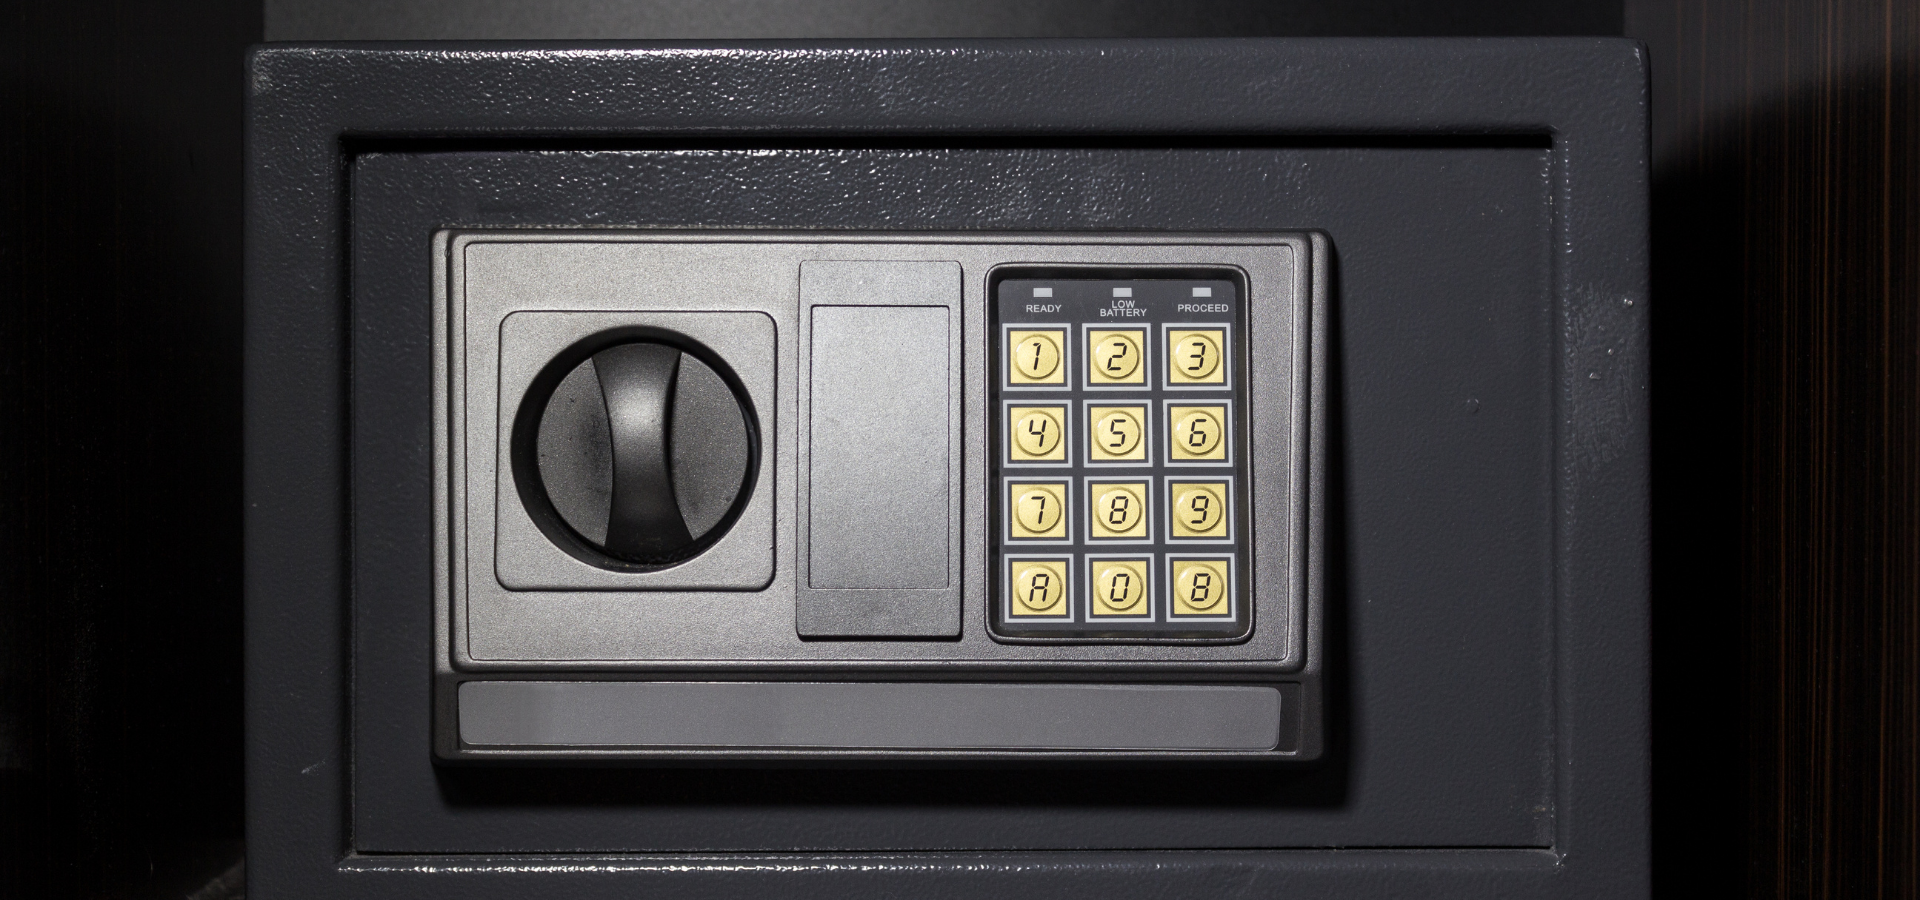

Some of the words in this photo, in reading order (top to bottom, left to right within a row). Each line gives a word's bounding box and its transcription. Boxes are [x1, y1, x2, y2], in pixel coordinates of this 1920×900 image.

[1025, 304, 1063, 313] READY
[1099, 309, 1148, 318] BATTERY
[1111, 300, 1136, 309] LOW
[1177, 304, 1229, 313] PROCEED
[1032, 342, 1042, 371] 1
[1107, 343, 1127, 370] 2
[1188, 343, 1206, 370] 3
[1028, 420, 1047, 447] 4
[1109, 420, 1126, 446] 5
[1188, 419, 1207, 446] 6
[1030, 497, 1046, 524] 7
[1109, 497, 1129, 524] 8
[1191, 496, 1209, 523] 9
[1029, 574, 1050, 601] A
[1110, 574, 1130, 601] 0
